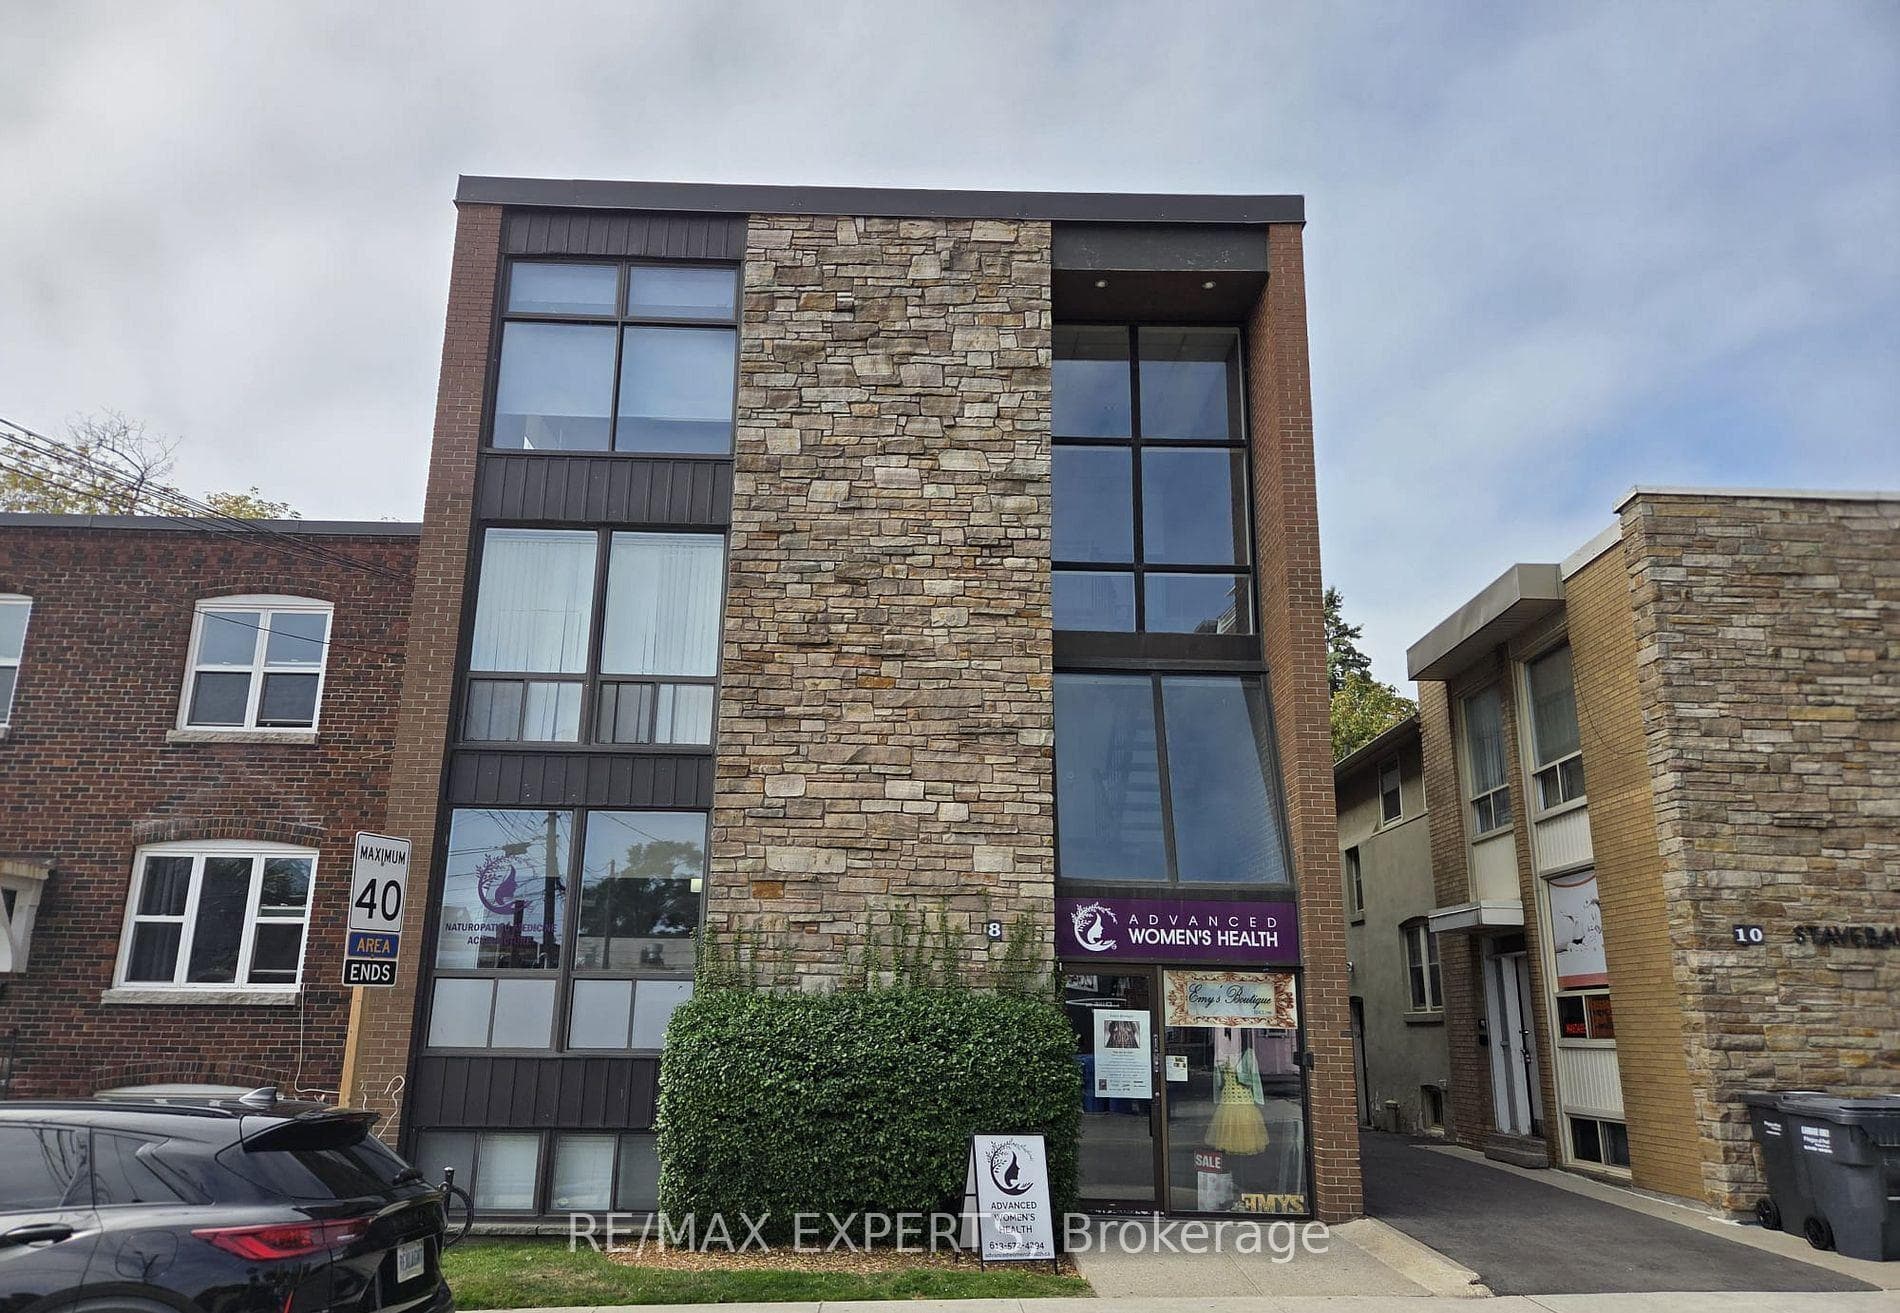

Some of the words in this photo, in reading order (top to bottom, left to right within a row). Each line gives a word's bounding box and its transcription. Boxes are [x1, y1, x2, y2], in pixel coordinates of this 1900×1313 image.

[360, 845, 406, 865] MAXIMUM
[355, 878, 401, 921] 40
[1129, 914, 1277, 928] ADVANCED
[988, 922, 1001, 937] 8
[1128, 928, 1212, 946] WOMEN'S
[1217, 930, 1278, 947] HEALTH
[1735, 928, 1763, 942] 10
[356, 937, 391, 954] AREA
[350, 963, 391, 981] ENDS
[1224, 984, 1271, 1009] Boutique
[1195, 1153, 1222, 1169] SALE
[993, 1213, 1036, 1221] WOMEN'S
[998, 1225, 1033, 1234] HEALTH
